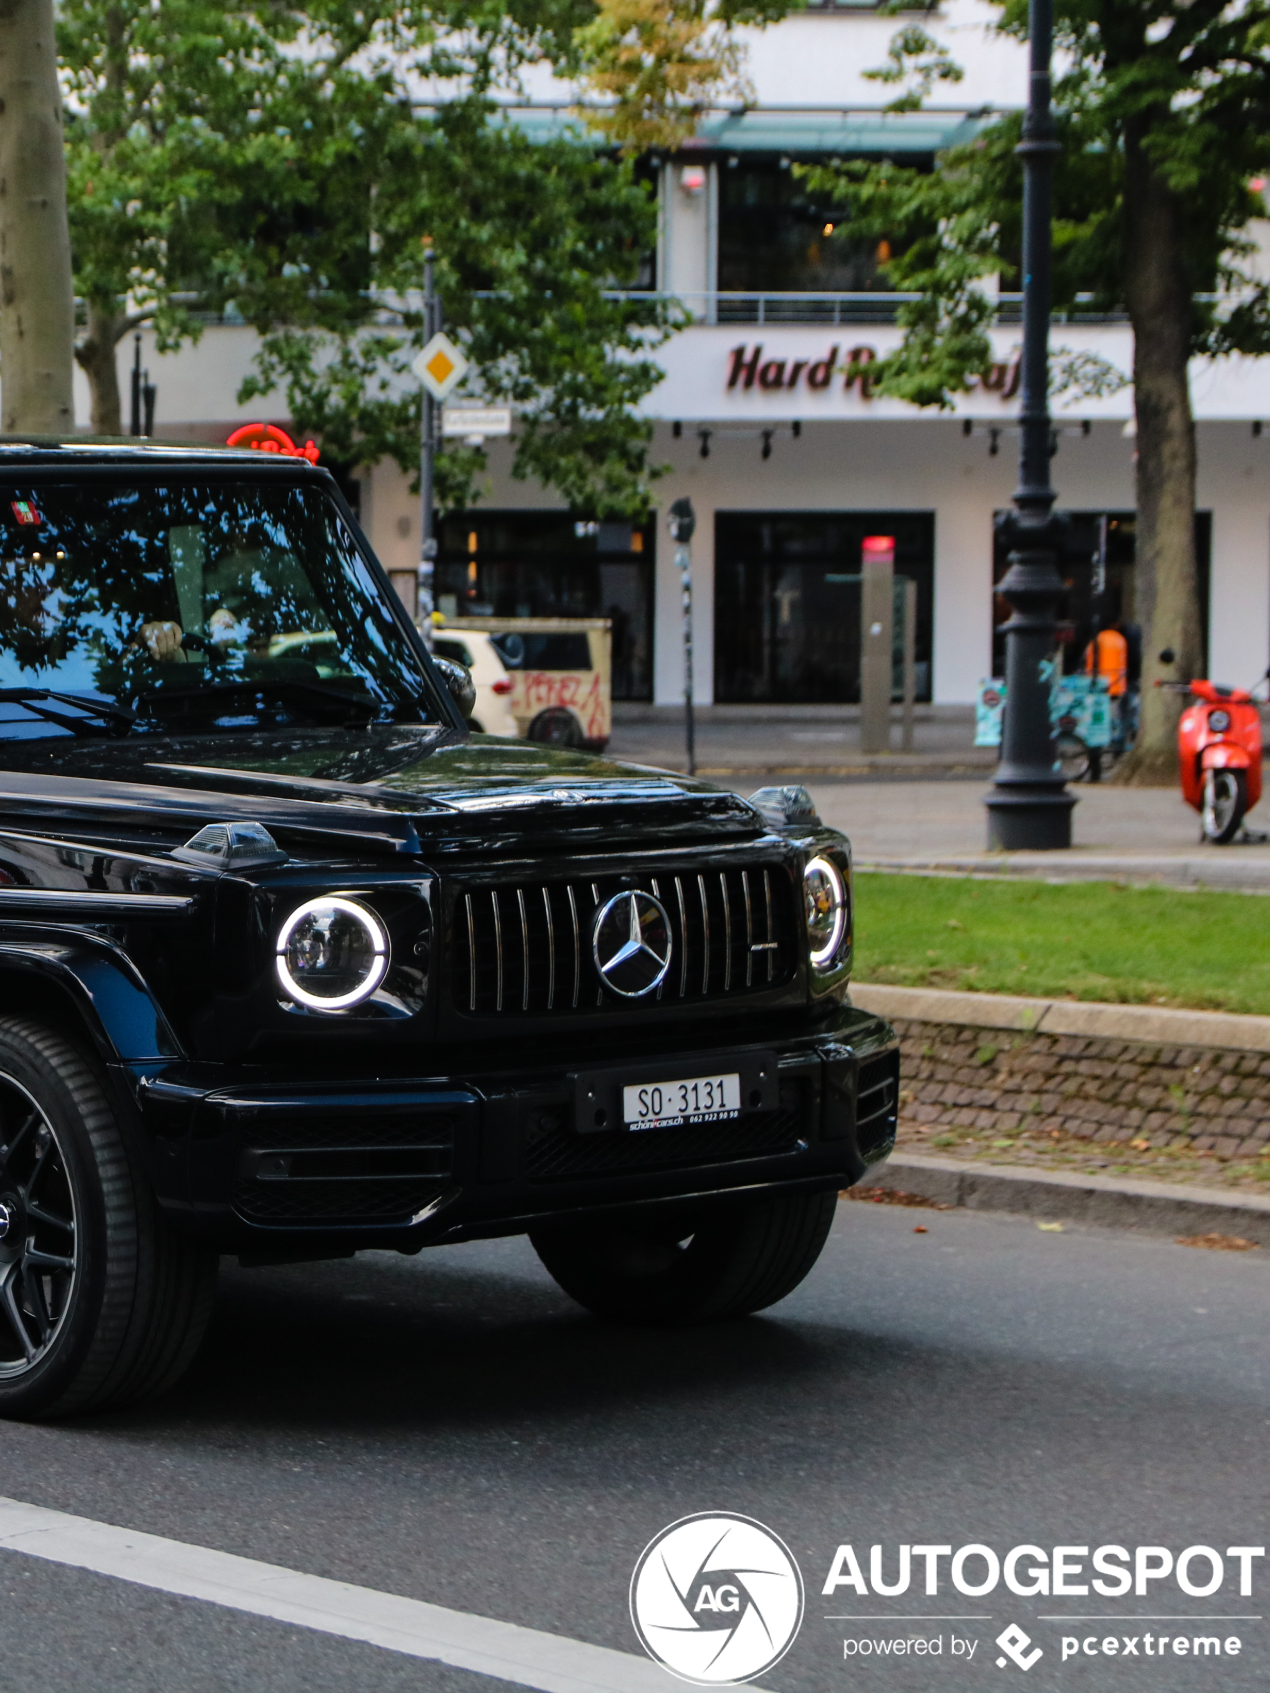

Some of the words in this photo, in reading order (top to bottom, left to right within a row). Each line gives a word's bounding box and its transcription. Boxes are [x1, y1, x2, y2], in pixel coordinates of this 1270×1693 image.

[727, 345, 839, 391] Hard
[689, 1114, 703, 1123] 062
[704, 1112, 717, 1122] 922
[718, 1111, 728, 1120] 90
[729, 1110, 739, 1119] 90
